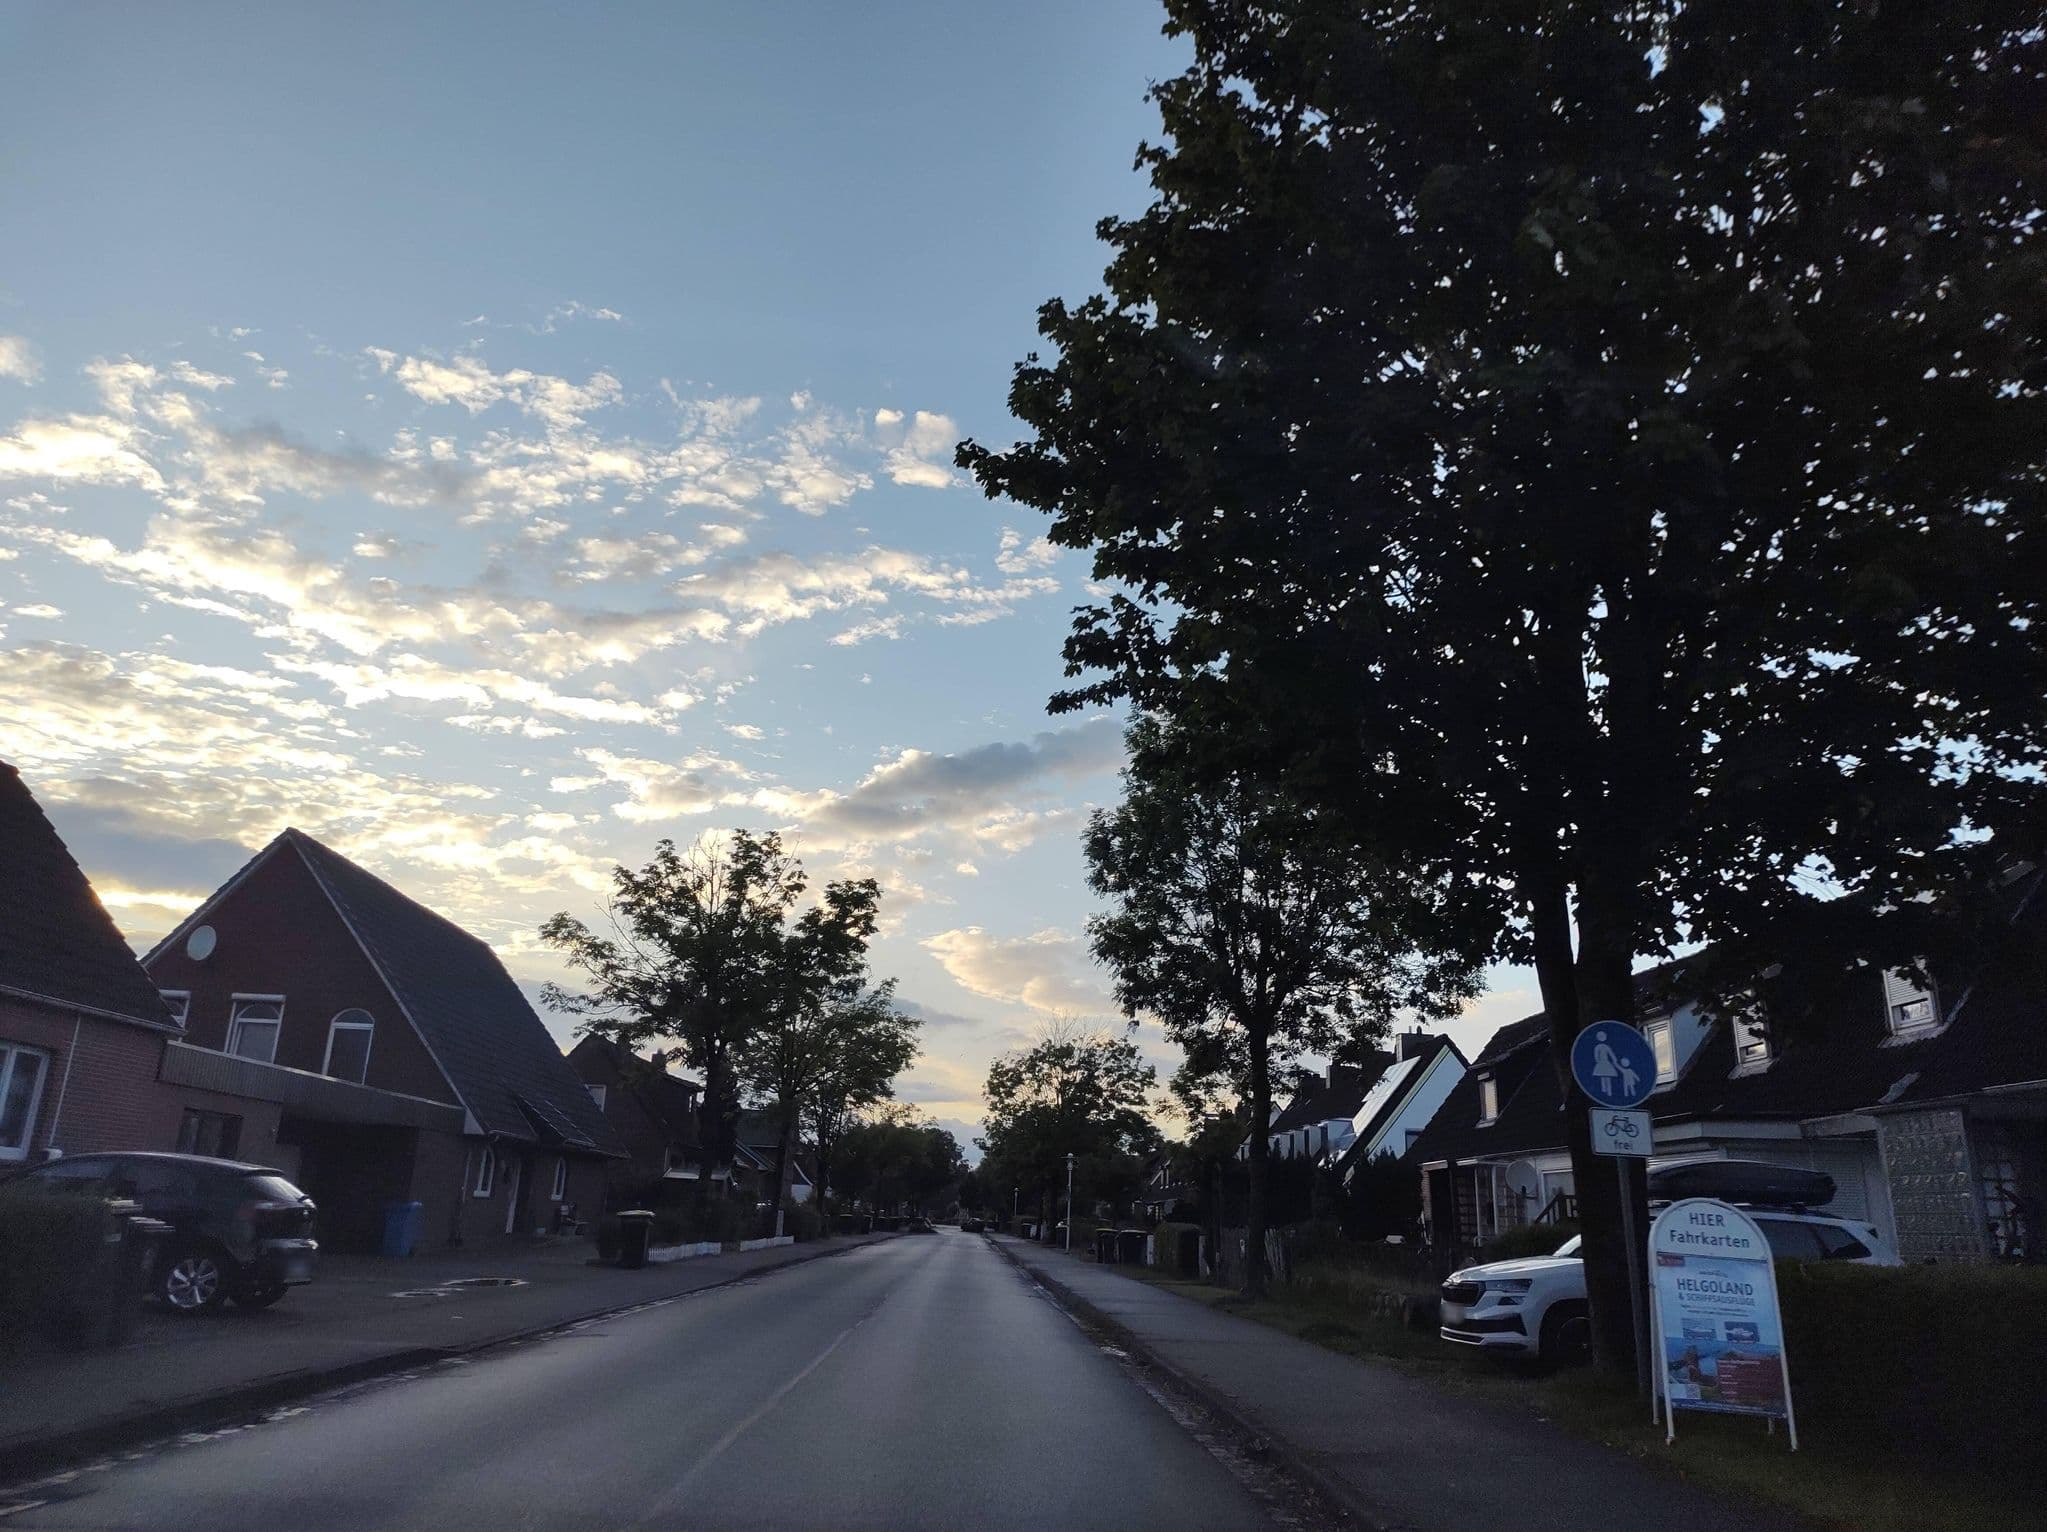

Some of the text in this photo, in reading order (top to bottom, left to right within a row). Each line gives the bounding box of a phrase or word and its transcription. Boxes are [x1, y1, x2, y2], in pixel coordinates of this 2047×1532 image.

[1614, 1140, 1633, 1150] frei
[1688, 1212, 1725, 1227] HIER
[1669, 1229, 1750, 1249] Fahrkarten
[1676, 1278, 1753, 1296] HELGOLAND
